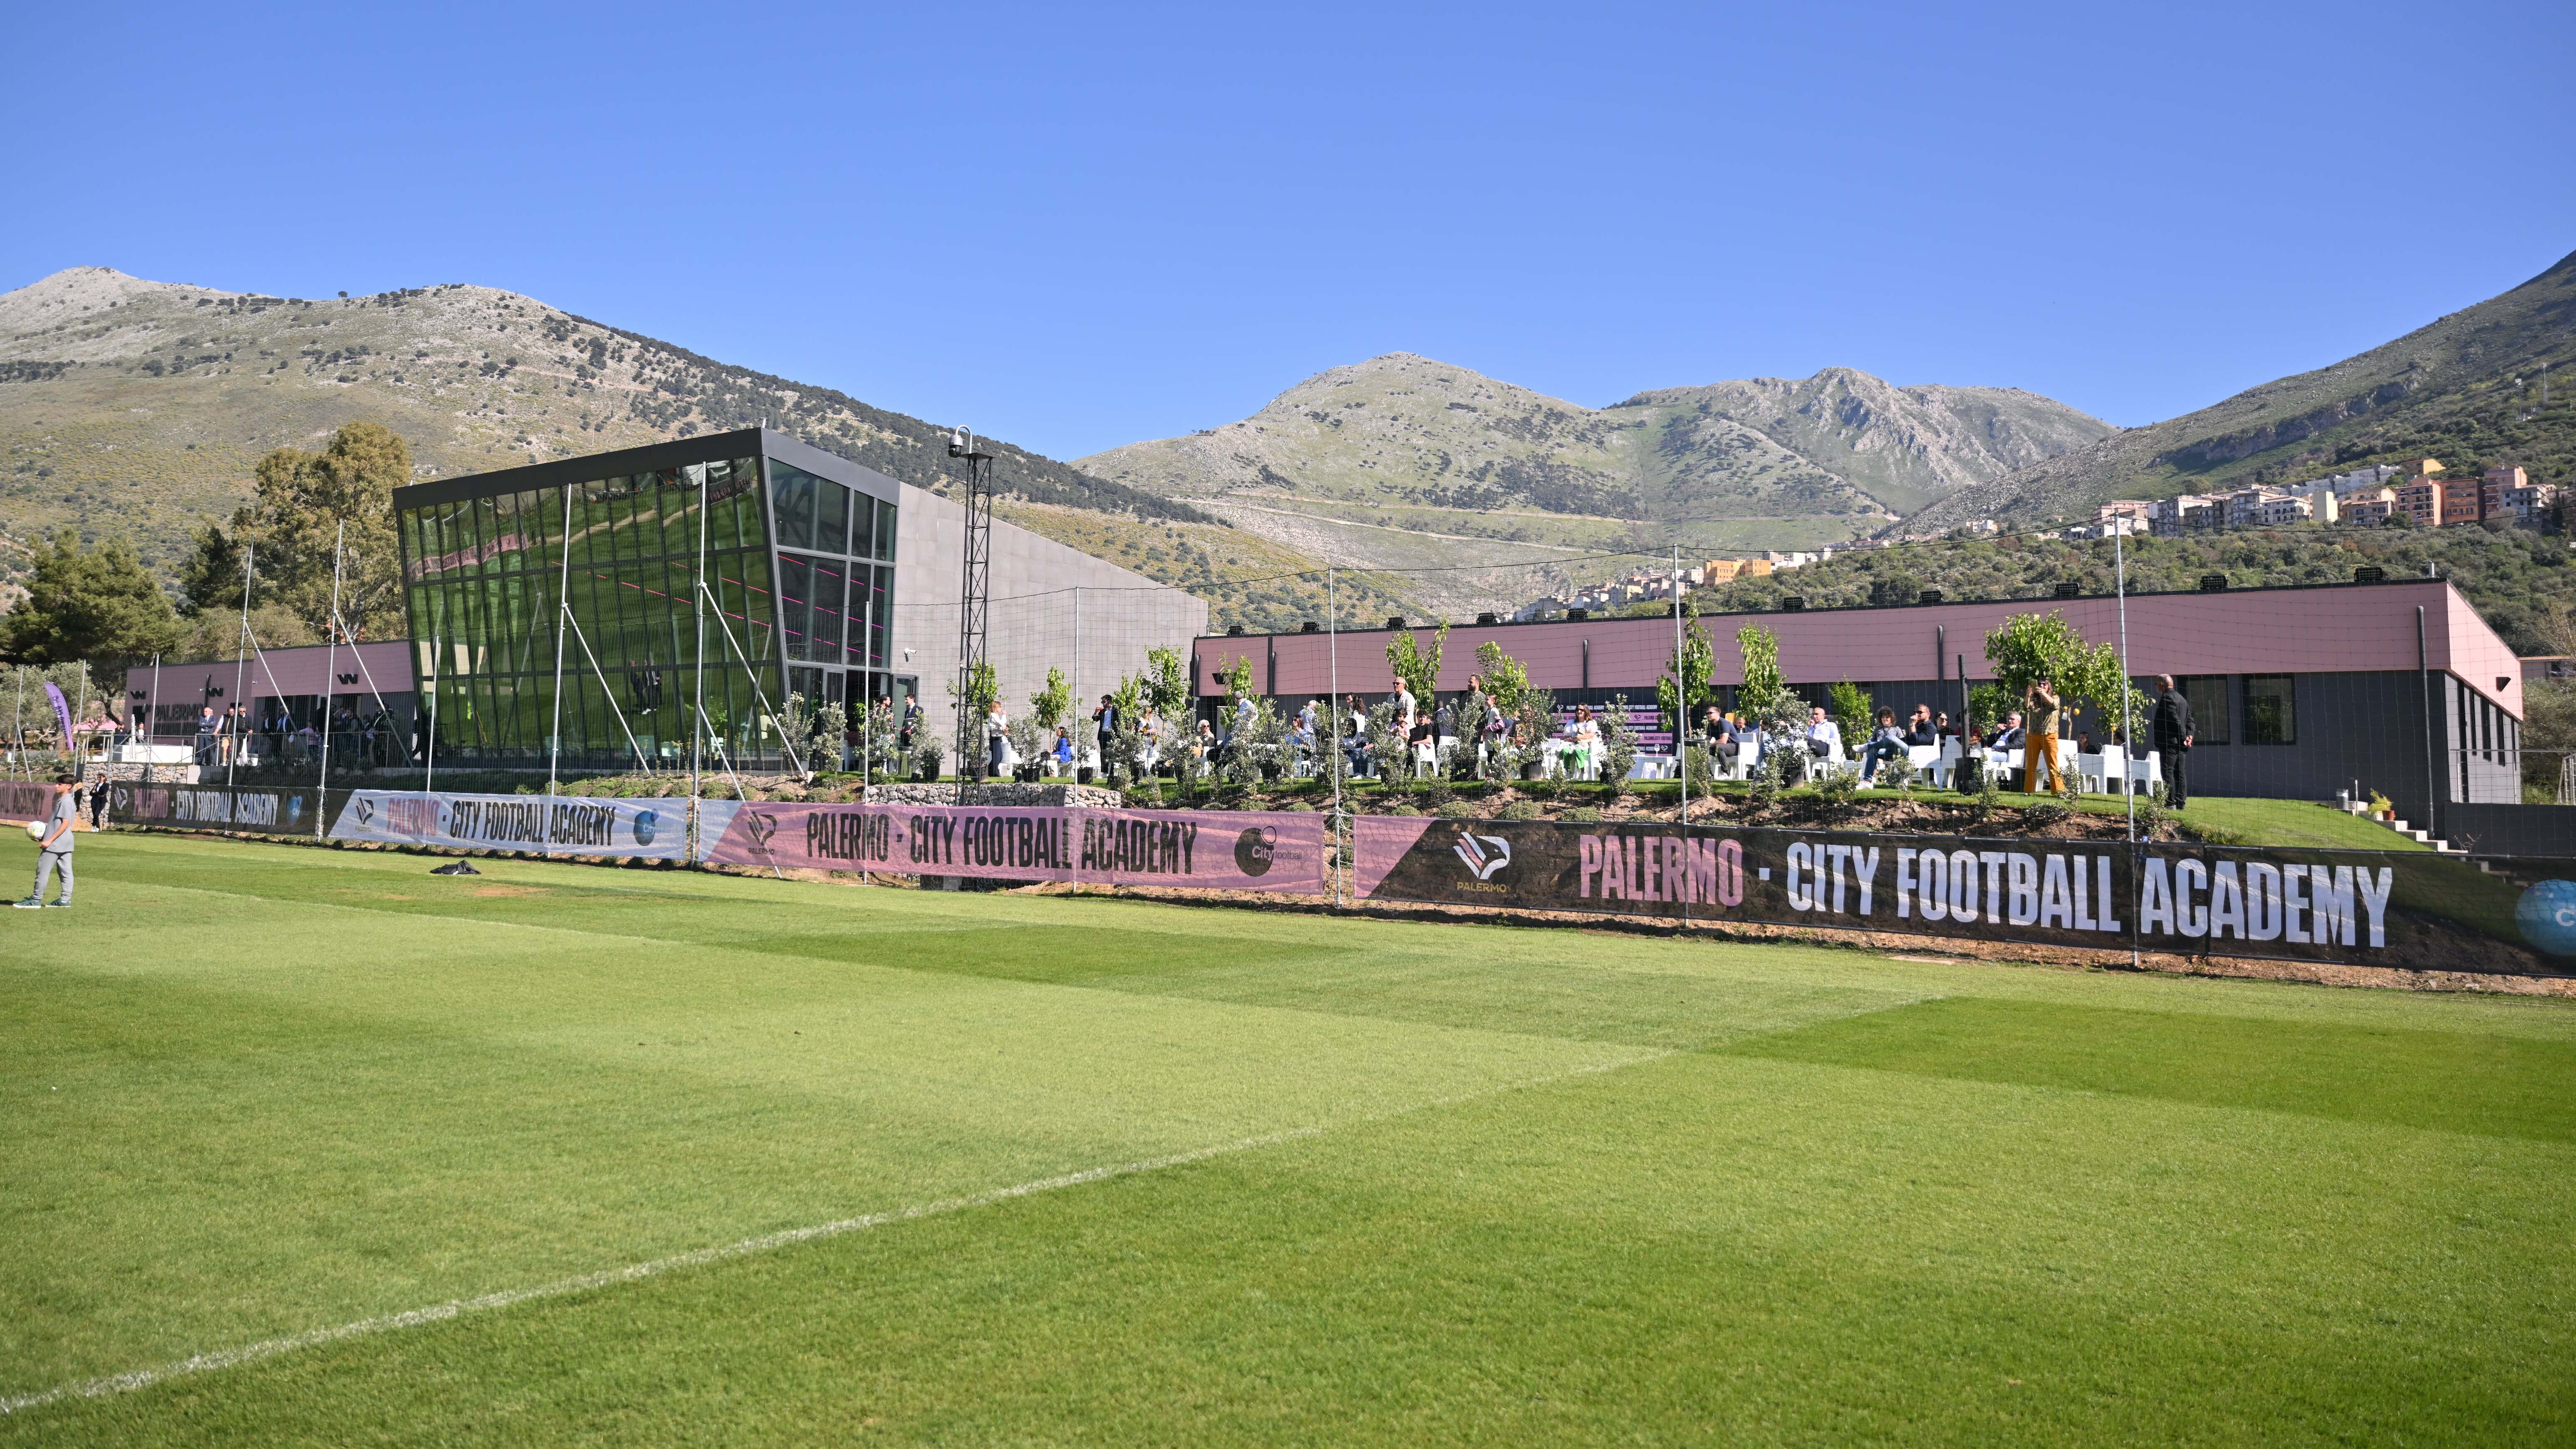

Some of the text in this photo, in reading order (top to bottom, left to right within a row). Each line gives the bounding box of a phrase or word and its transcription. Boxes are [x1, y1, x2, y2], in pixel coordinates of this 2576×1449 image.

[155, 703, 203, 721] PALERMO
[12, 788, 45, 815] ACADEMY
[133, 788, 169, 818] PALERMO
[176, 790, 194, 820] CITY
[196, 791, 232, 822] FOOTBALL
[235, 793, 278, 826] ACADEMY
[386, 798, 440, 836] PALERMO
[450, 800, 481, 839] CITY
[482, 802, 544, 842] FOOTBALL
[548, 804, 617, 846] ACADEMY
[807, 812, 889, 862] PALERMO
[910, 816, 957, 864] CITY
[963, 816, 1072, 869] FOOTBALL
[1081, 817, 1197, 874] ACADEMY
[1252, 846, 1302, 861] City football
[1457, 882, 1507, 893] PALERMO
[1580, 833, 1743, 906] PALERMO
[1786, 842, 1879, 915] CITY
[1897, 847, 2120, 932] FOOTBALL
[2140, 857, 2393, 948] ACADEMY
